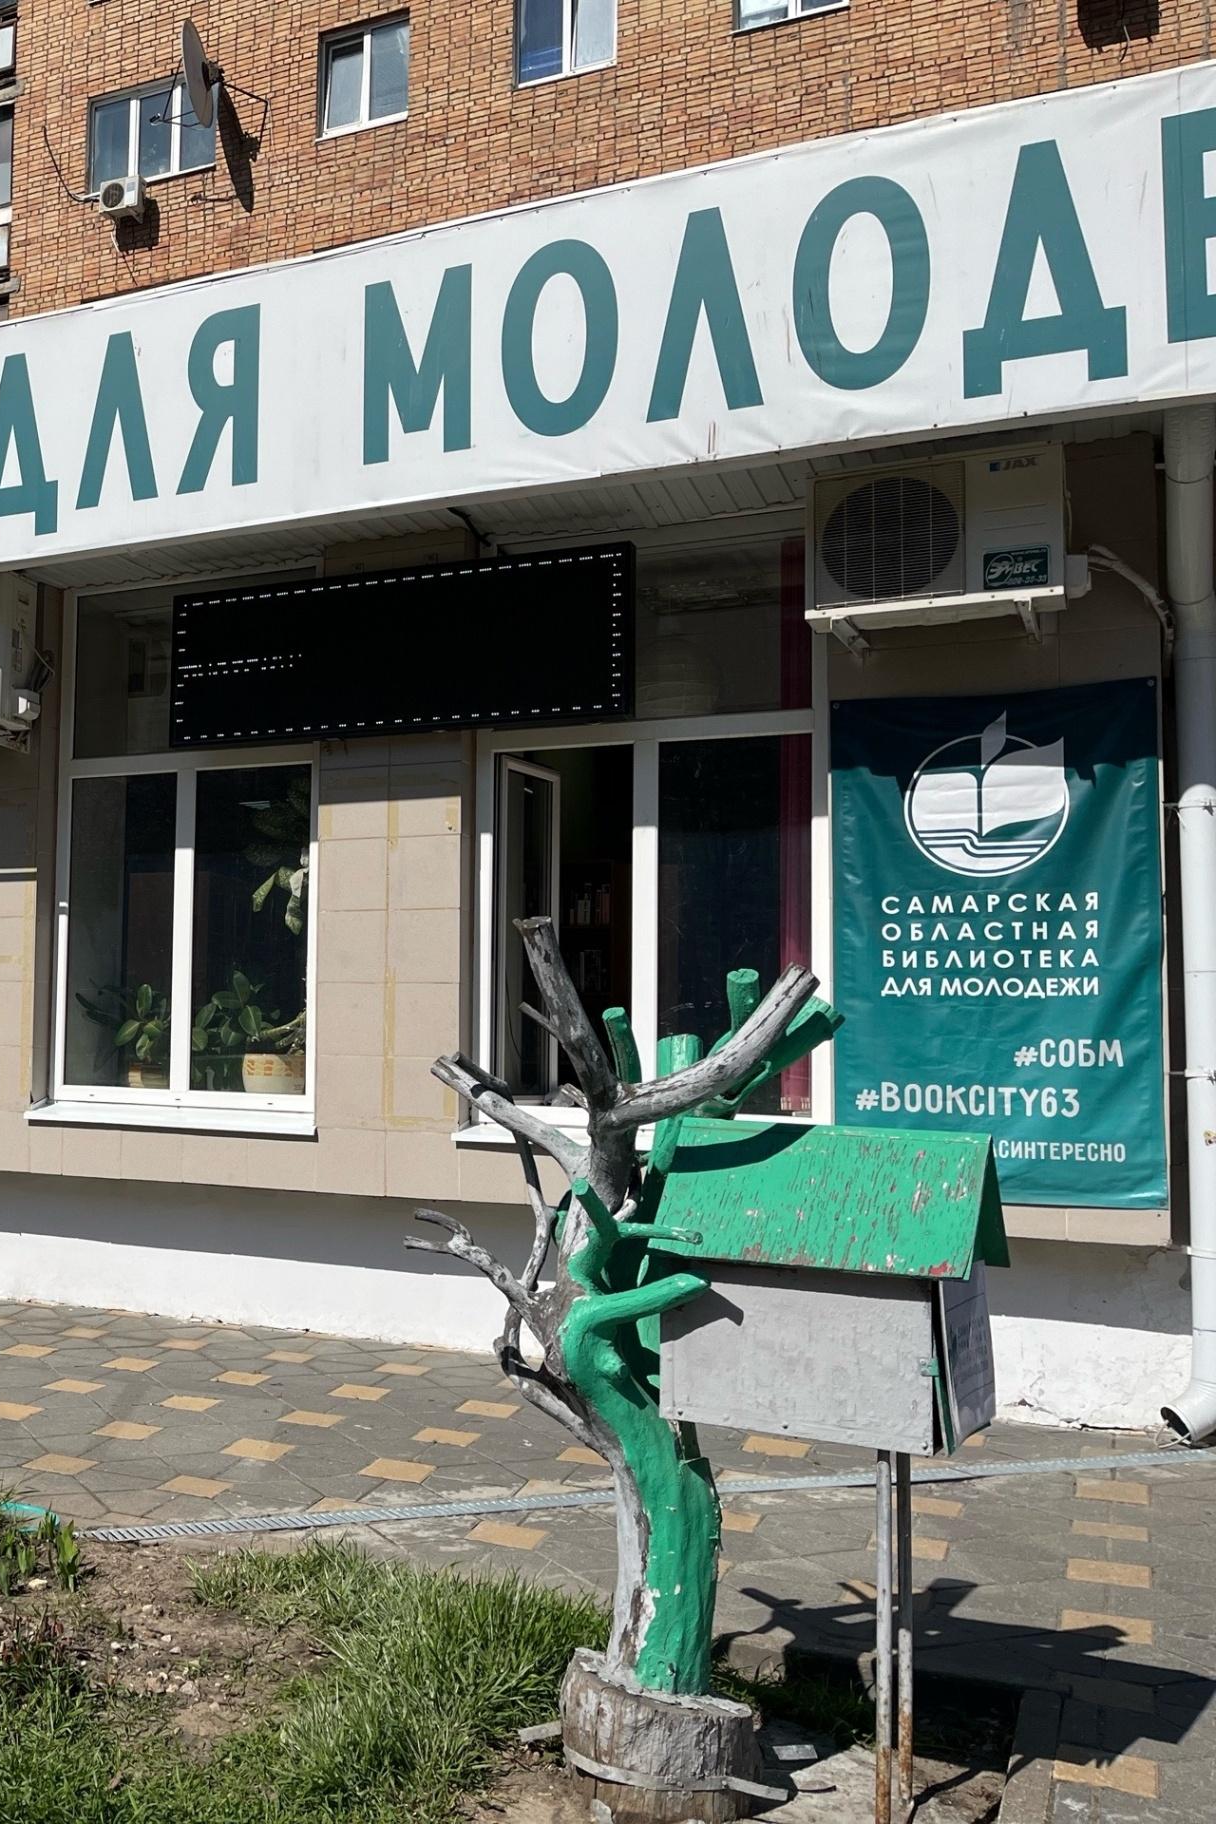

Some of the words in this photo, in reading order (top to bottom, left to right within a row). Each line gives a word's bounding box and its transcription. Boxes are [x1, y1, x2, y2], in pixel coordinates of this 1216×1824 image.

[362, 107, 1216, 466] МОЛОДЕ
[881, 892, 1099, 915] САМАРСКАЯ
[881, 920, 1099, 942] ОБЛАСТНАЯ
[882, 948, 1099, 969] БИБЛИОТЕКА
[881, 977, 932, 997] ДЛЯ
[940, 976, 1099, 998] МОЛОДЕЖИ
[1013, 1039, 1124, 1068] #СОБМ
[855, 1081, 1080, 1118] #BOOKCITY63
[992, 1139, 1126, 1163] СИНТЕРЕСНО
